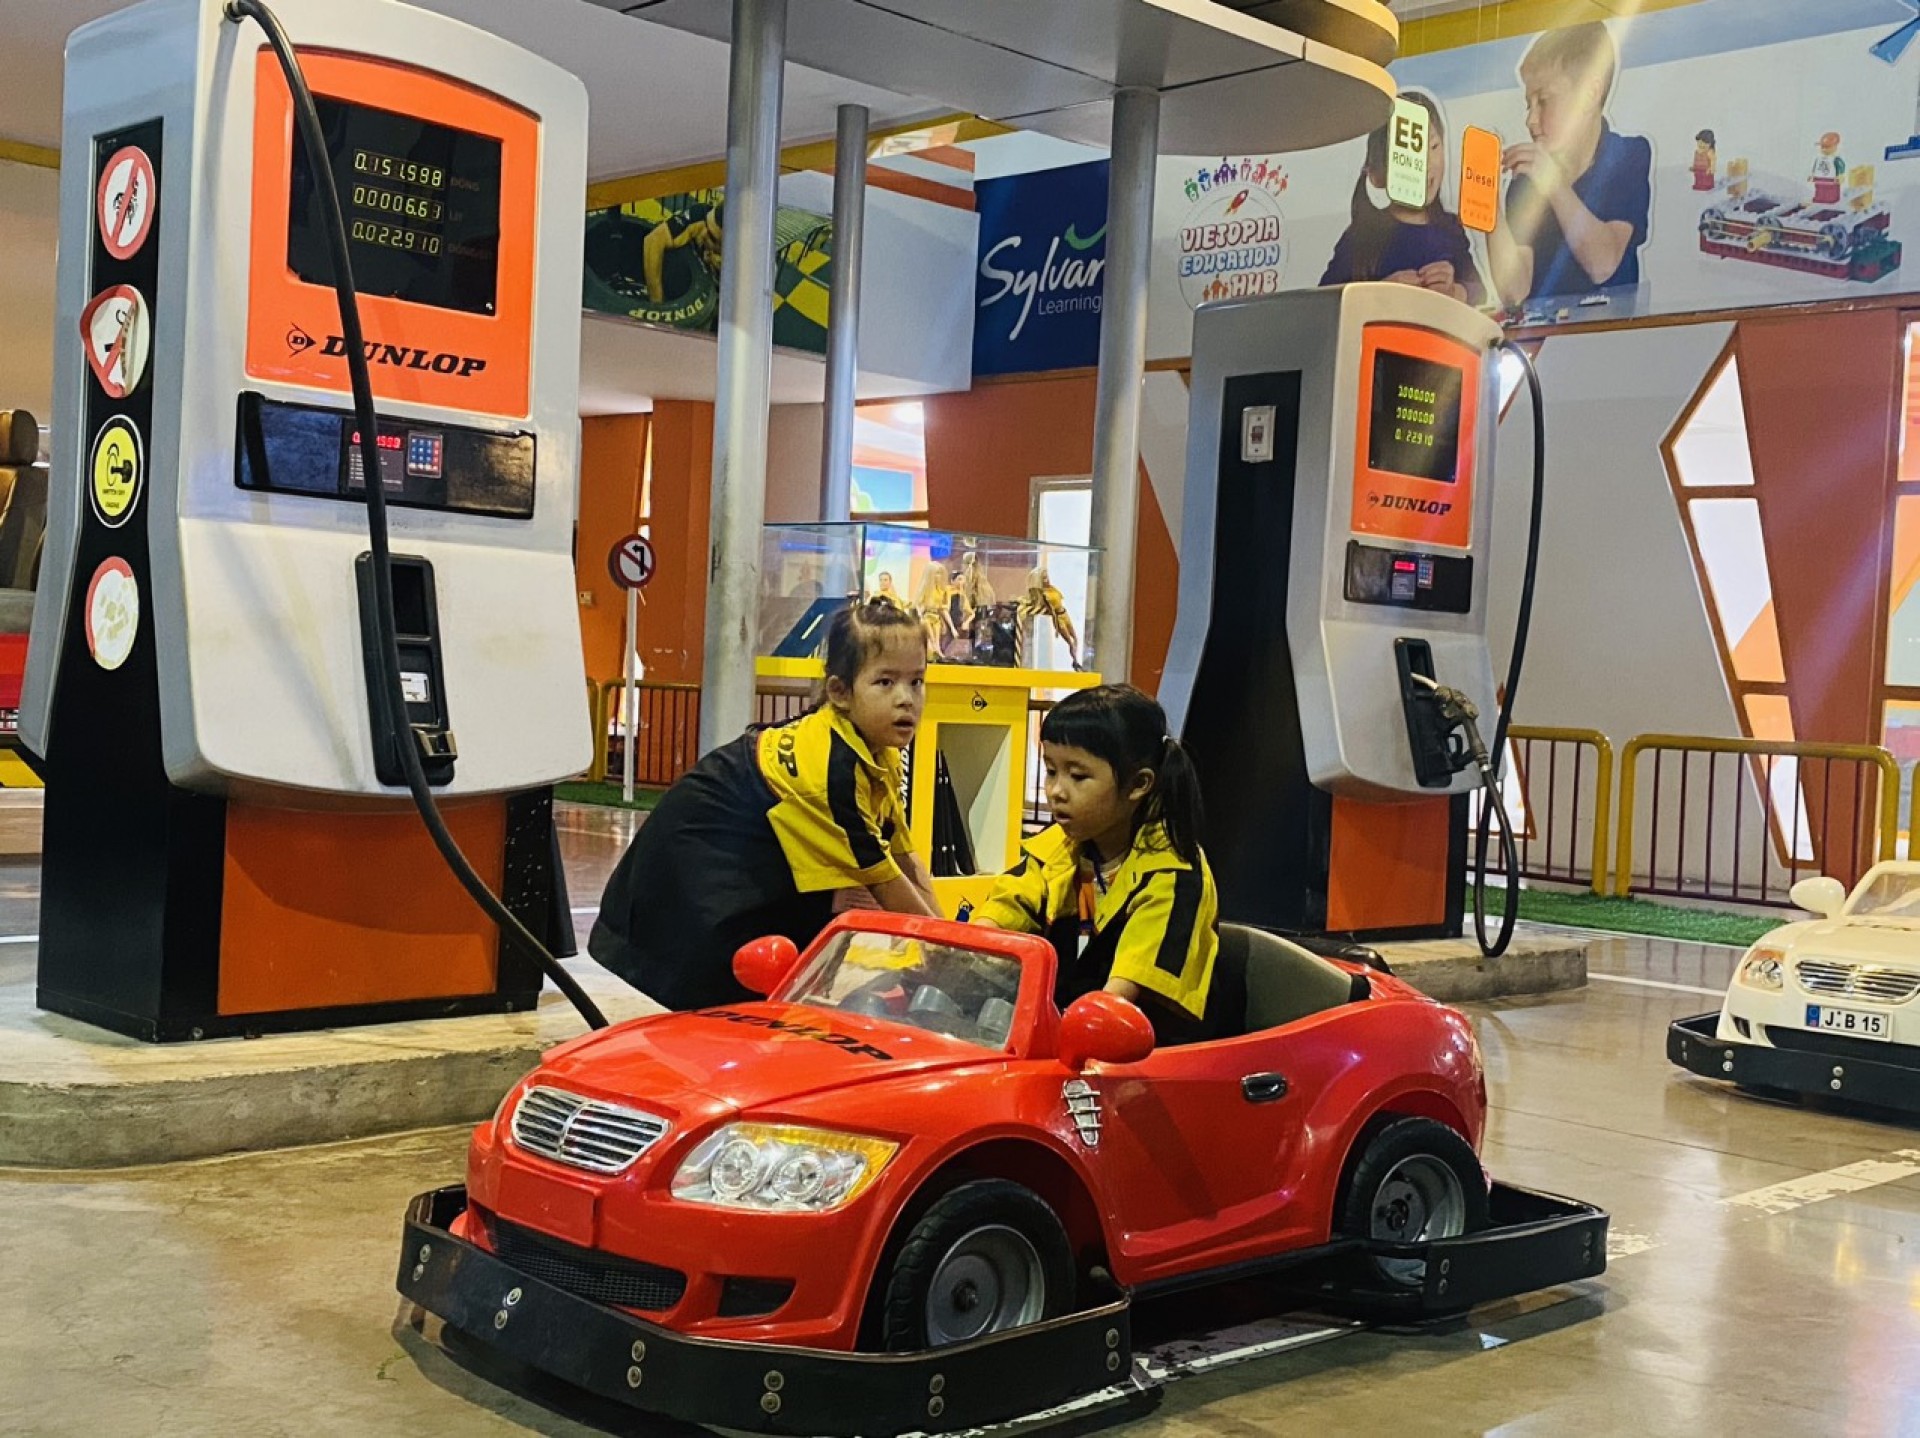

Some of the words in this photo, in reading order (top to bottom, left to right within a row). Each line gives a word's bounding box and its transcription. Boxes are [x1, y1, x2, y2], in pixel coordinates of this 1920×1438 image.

[1395, 116, 1423, 153] E5
[1392, 152, 1413, 168] RON
[1414, 159, 1424, 172] 92
[1465, 166, 1495, 189] Diesel
[1180, 215, 1280, 253] VIETOPIA
[1179, 244, 1280, 278] EDUCATION
[1231, 269, 1279, 298] HUB
[628, 297, 704, 322] DUNLOP
[1038, 294, 1102, 315] Learning
[1381, 494, 1452, 516] DUNLOP
[695, 1009, 894, 1060] DUNLOP
[1862, 1015, 1880, 1033] 15
